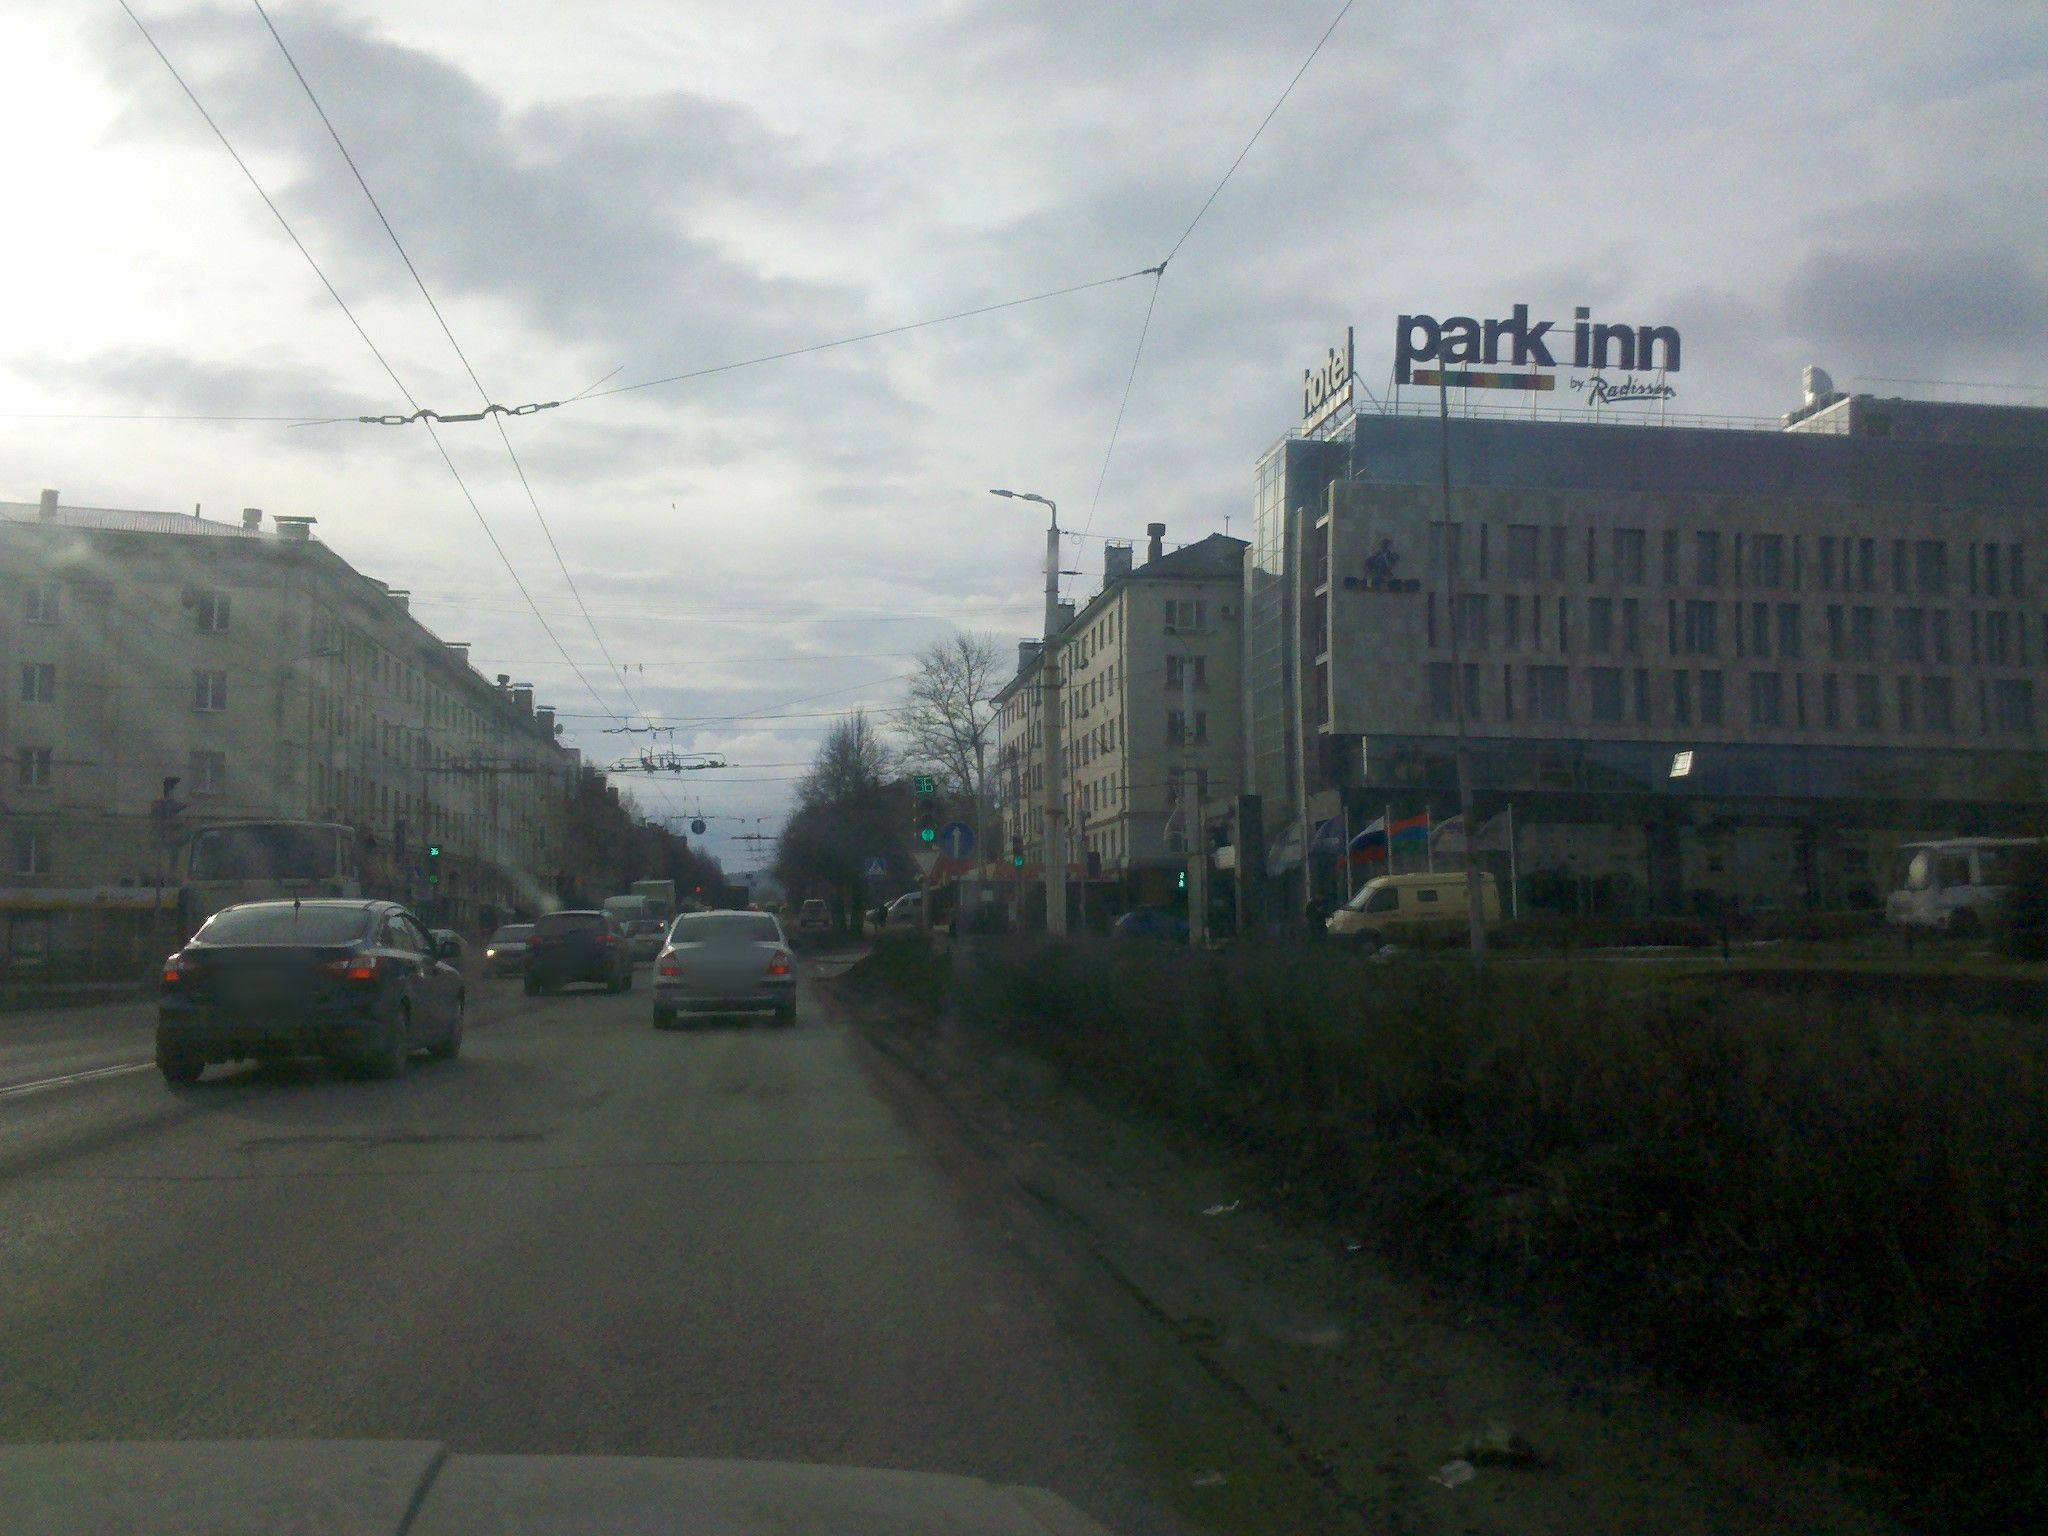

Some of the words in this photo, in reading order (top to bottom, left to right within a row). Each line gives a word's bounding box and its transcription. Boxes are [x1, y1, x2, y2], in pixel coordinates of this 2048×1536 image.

[1302, 326, 1354, 418] hotel
[1397, 304, 1556, 385] park
[1573, 306, 1680, 371] inn
[1570, 376, 1584, 392] by
[1589, 375, 1677, 405] Radisson
